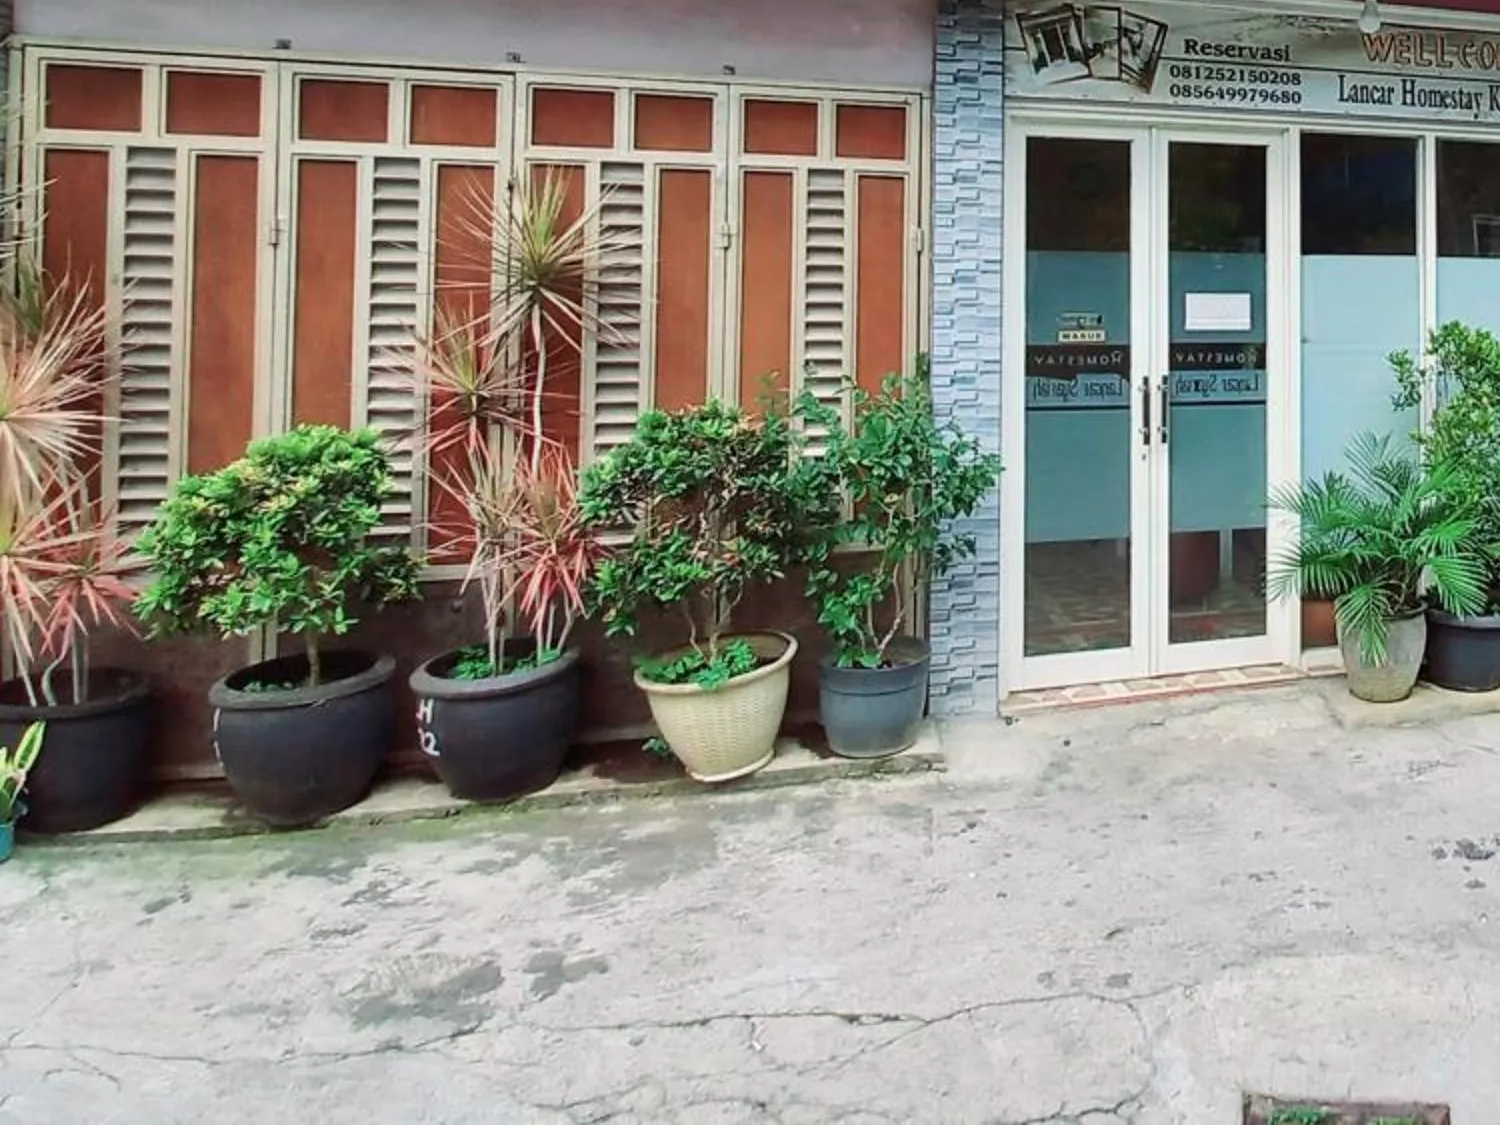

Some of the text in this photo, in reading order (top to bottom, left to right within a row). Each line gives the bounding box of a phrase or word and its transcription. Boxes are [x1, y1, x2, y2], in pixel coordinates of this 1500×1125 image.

[1183, 38, 1291, 62] Reservasi
[1169, 65, 1302, 86] 081252150208
[1169, 83, 1302, 104] 085649979680
[1338, 74, 1395, 106] Lancar
[1401, 78, 1482, 119] Homestay
